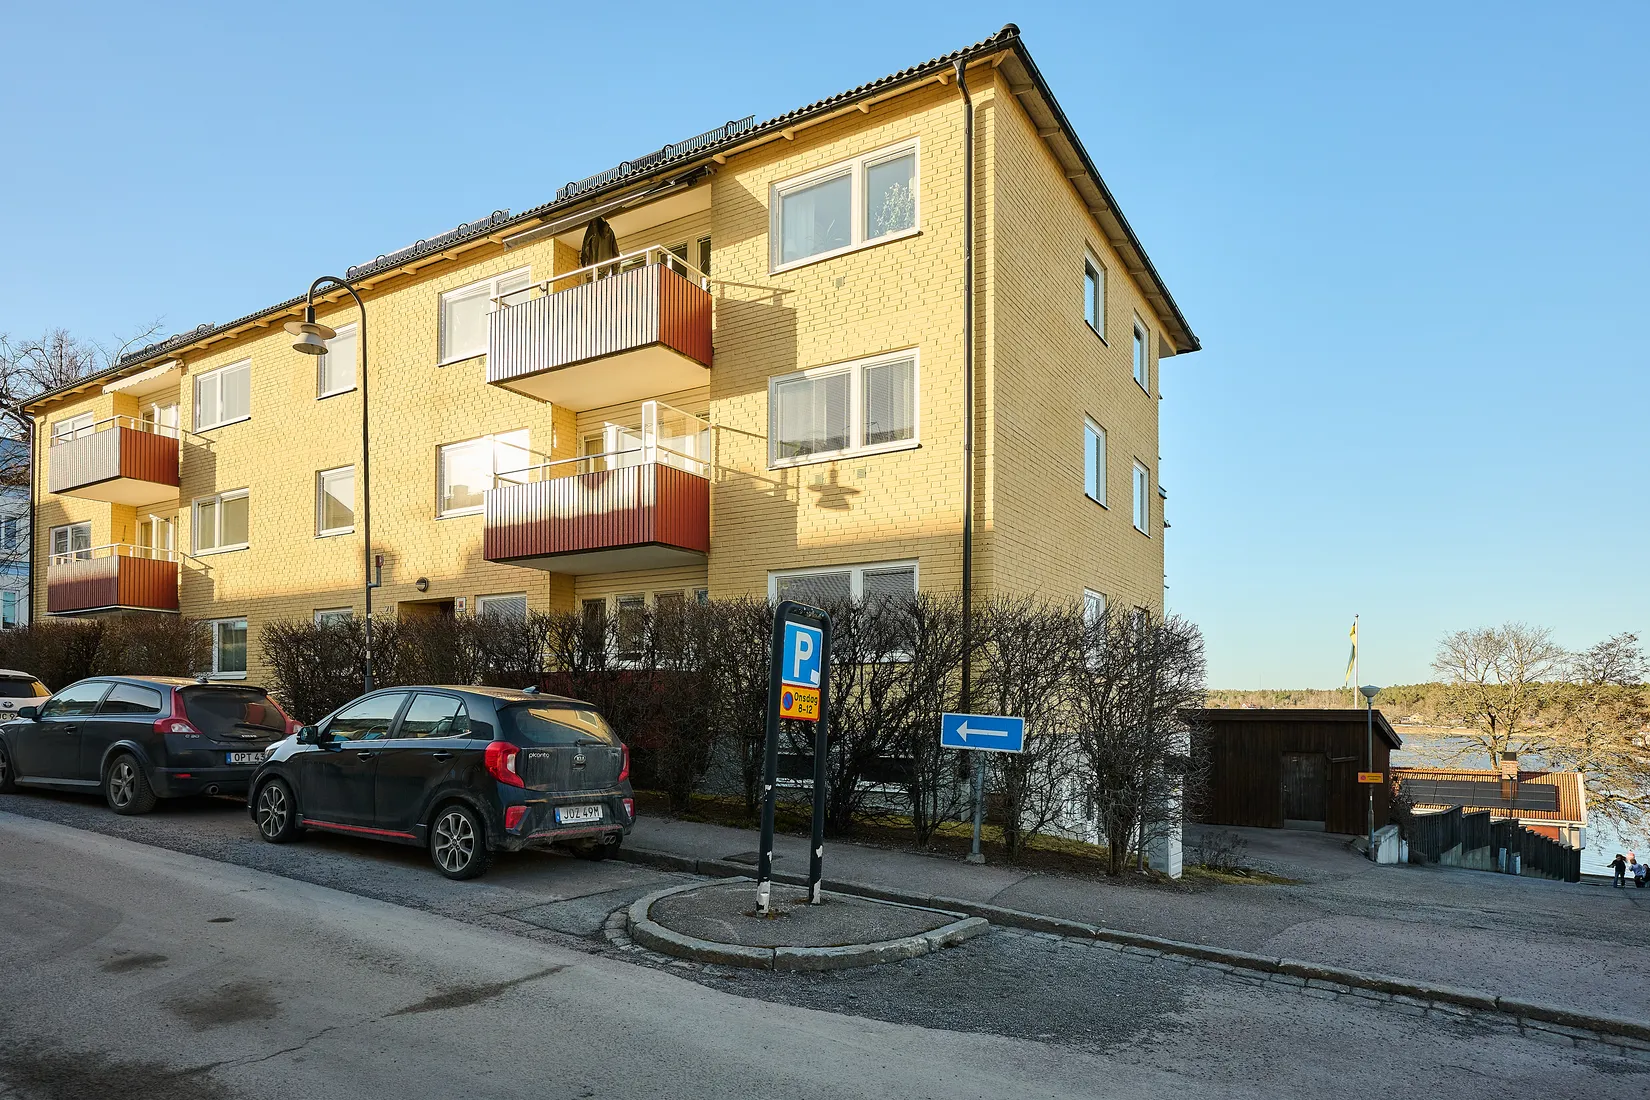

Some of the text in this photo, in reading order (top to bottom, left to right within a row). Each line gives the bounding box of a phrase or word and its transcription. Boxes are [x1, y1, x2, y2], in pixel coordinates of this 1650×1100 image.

[793, 630, 814, 678] P
[794, 691, 818, 706] Onsdag
[798, 703, 813, 714] 8-12
[234, 753, 252, 762] OPT
[563, 806, 600, 819] JOZ 49M
